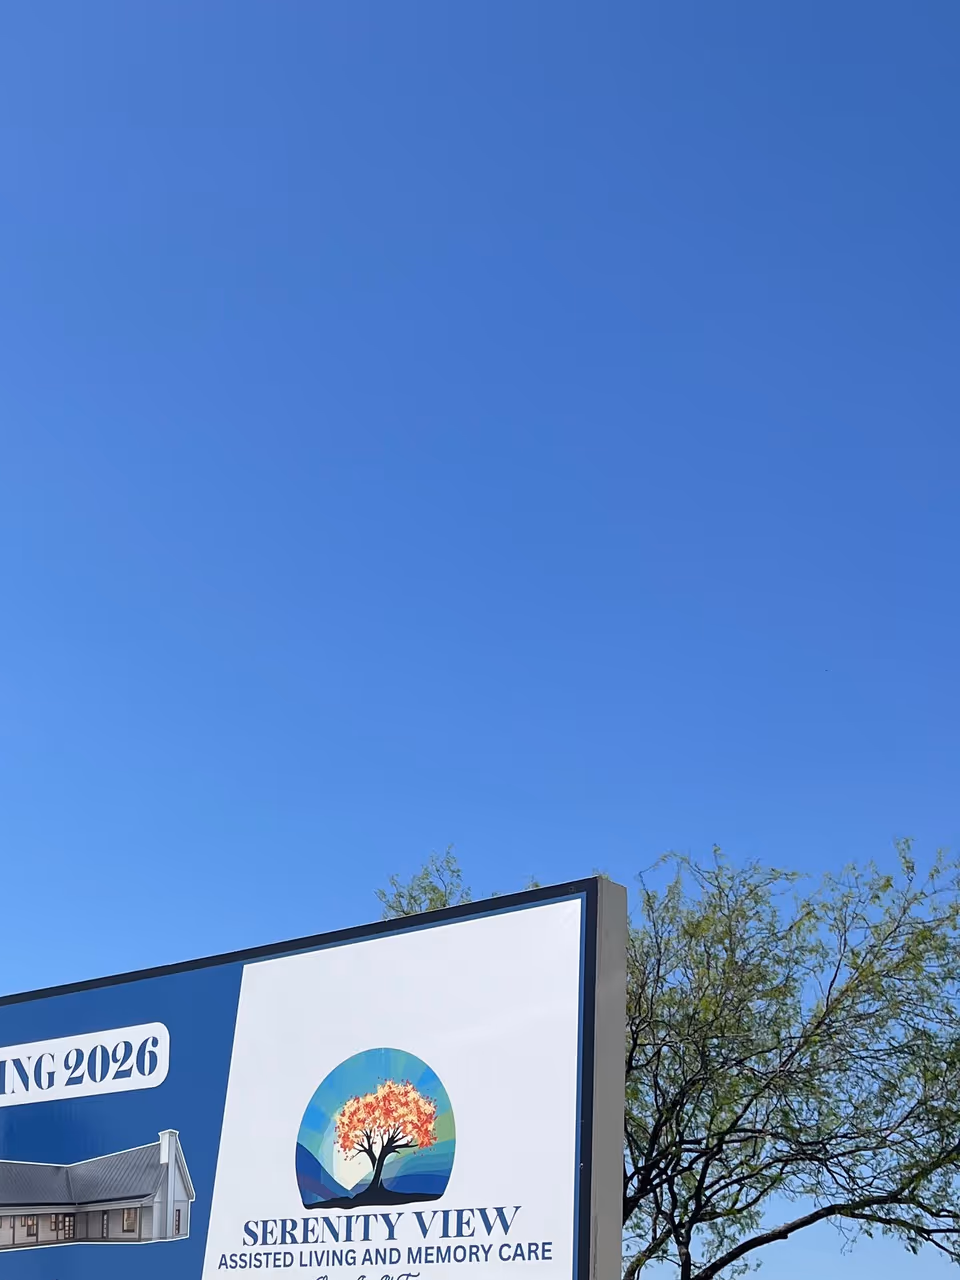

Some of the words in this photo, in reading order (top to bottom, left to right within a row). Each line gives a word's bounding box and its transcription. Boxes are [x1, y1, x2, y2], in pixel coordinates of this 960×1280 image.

[63, 1036, 160, 1086] 2026
[242, 1212, 405, 1246] SERENITY
[412, 1206, 522, 1240] VIEW
[218, 1252, 294, 1270] ASSISTED
[299, 1249, 357, 1268] LIVING
[361, 1247, 402, 1266] AND
[407, 1244, 494, 1264] MEMORY
[498, 1242, 553, 1261] CARE
